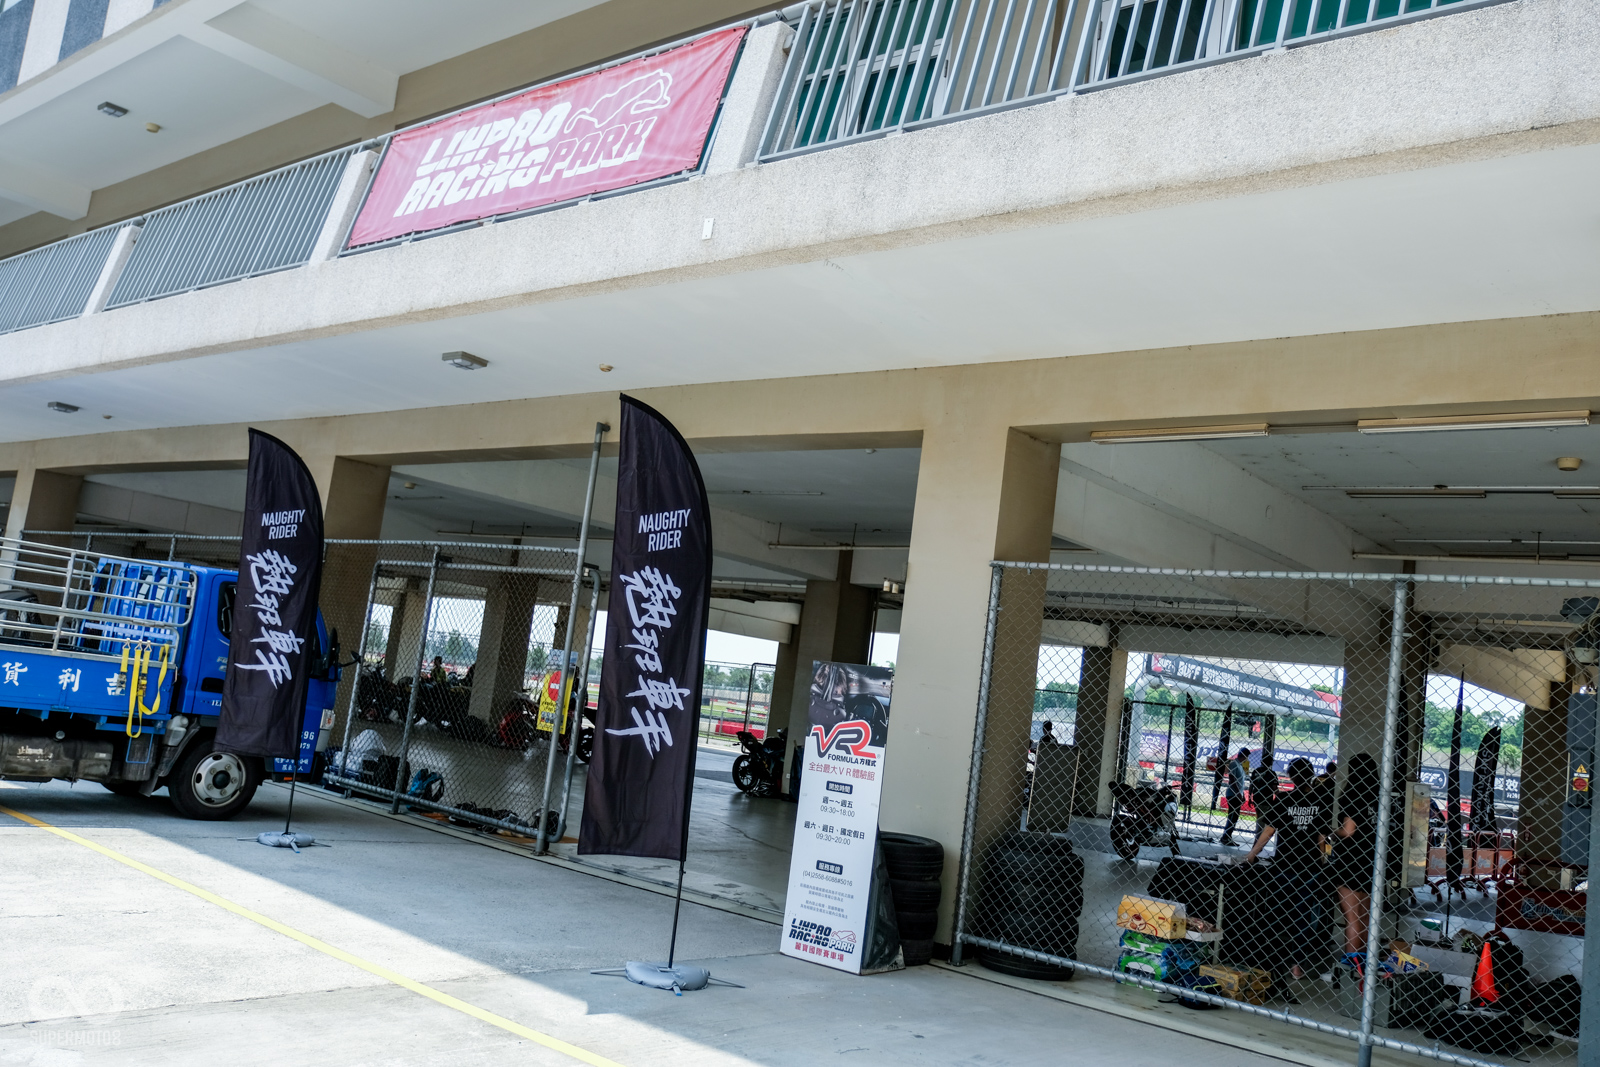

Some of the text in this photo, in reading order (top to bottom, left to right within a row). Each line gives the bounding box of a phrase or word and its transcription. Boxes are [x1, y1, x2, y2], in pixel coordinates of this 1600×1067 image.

[539, 116, 657, 184] PARK
[261, 509, 305, 526] NAUGHTY
[638, 508, 691, 533] NAUGHTY
[268, 524, 297, 540] RIDER
[648, 530, 681, 552] RIDER
[810, 719, 877, 758] VR
[827, 753, 877, 767] FORMULA 方程式
[1287, 806, 1319, 816] NAUGHTY
[1293, 816, 1314, 825] RIDER
[828, 937, 855, 954] PARK
